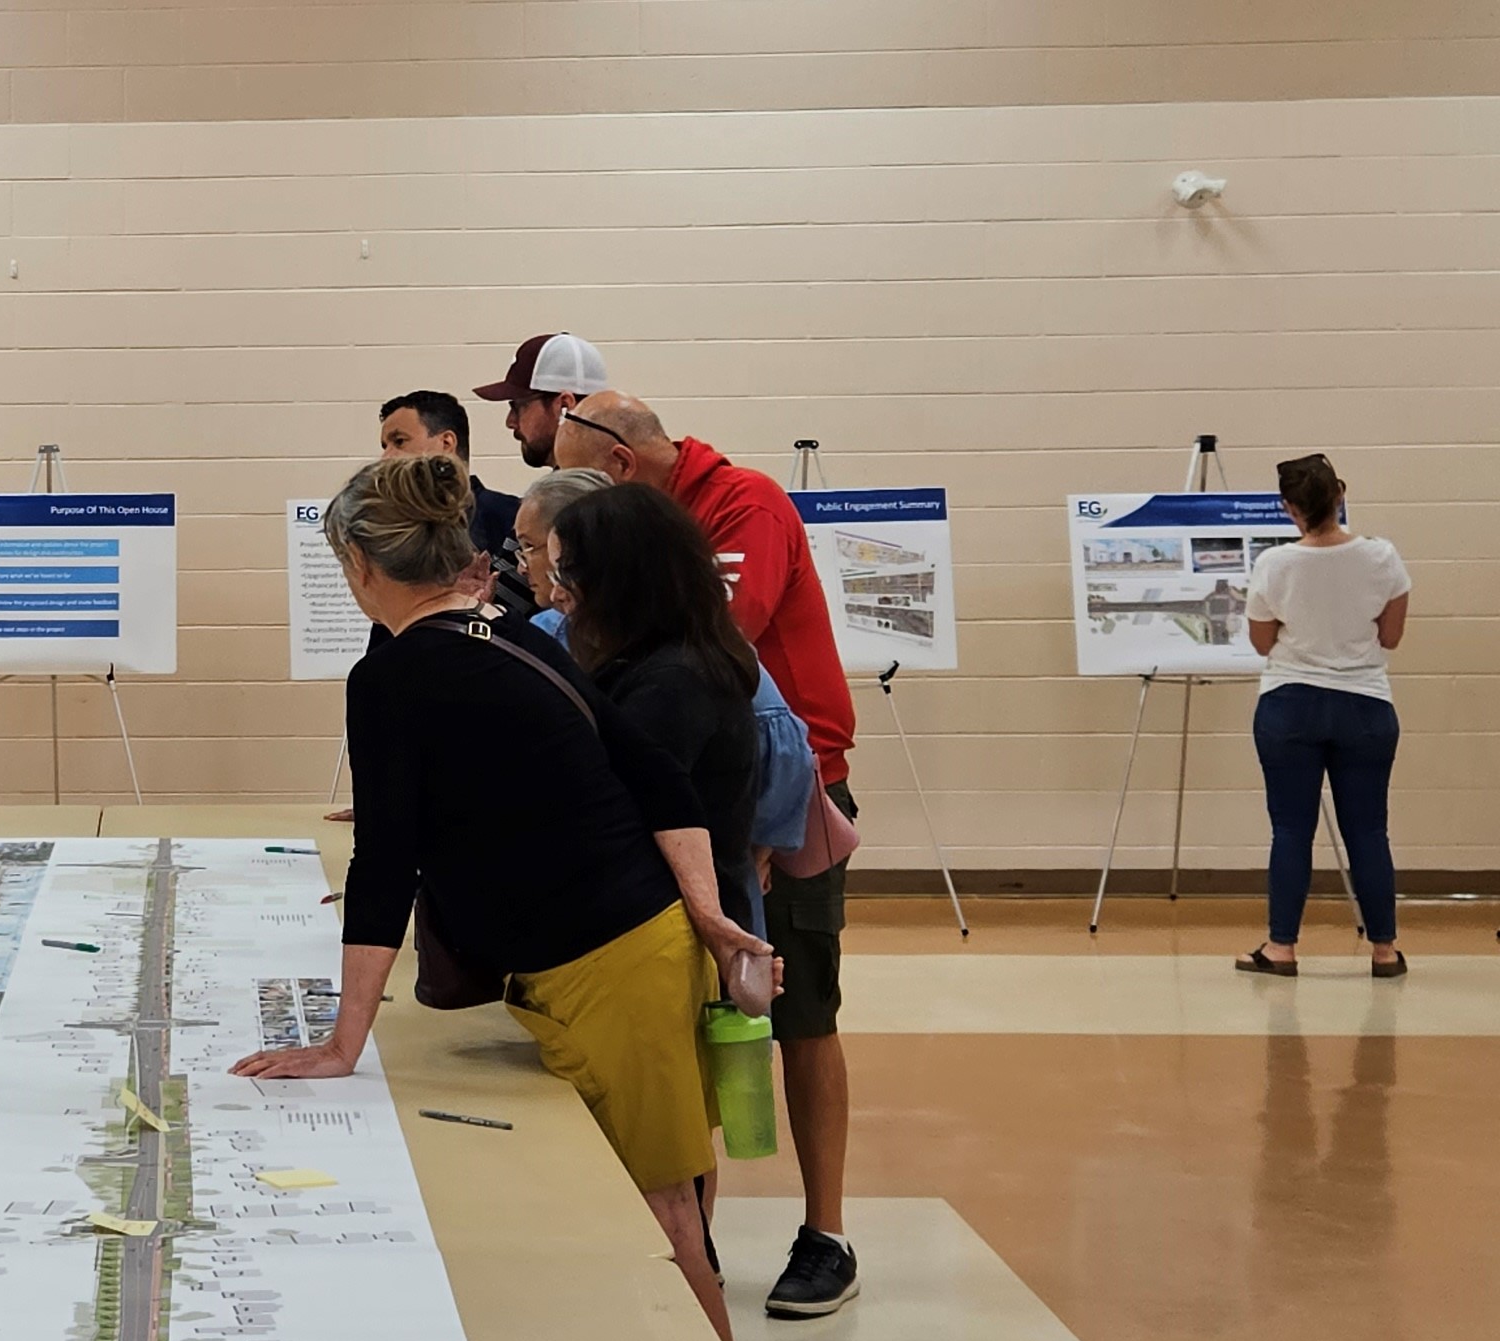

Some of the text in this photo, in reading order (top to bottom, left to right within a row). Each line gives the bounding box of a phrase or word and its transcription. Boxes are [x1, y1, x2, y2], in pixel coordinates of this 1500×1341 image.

[50, 506, 169, 516] Purpose Of This Open House
[816, 501, 940, 512] Public Engagement Summary
[1078, 500, 1102, 515] EG
[1234, 501, 1275, 511] Proposed
[296, 506, 319, 520] EG
